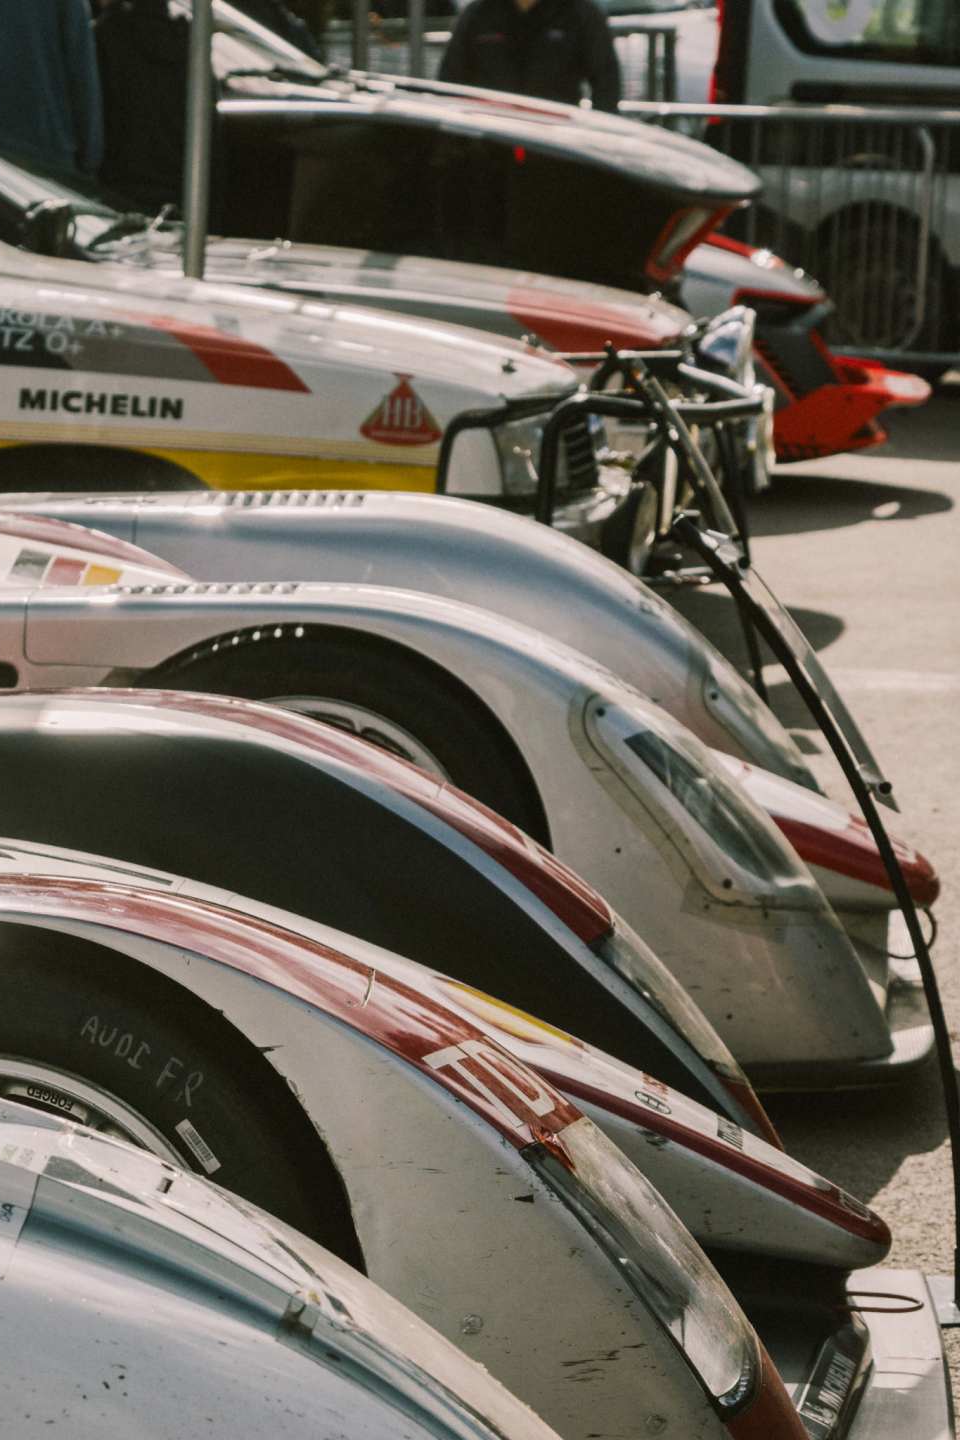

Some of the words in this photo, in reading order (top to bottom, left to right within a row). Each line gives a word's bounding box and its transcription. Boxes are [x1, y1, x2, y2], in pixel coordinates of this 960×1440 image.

[19, 388, 184, 420] MICHELIN
[80, 1015, 151, 1069] AUDI
[817, 1351, 857, 1410] MICHELIN
